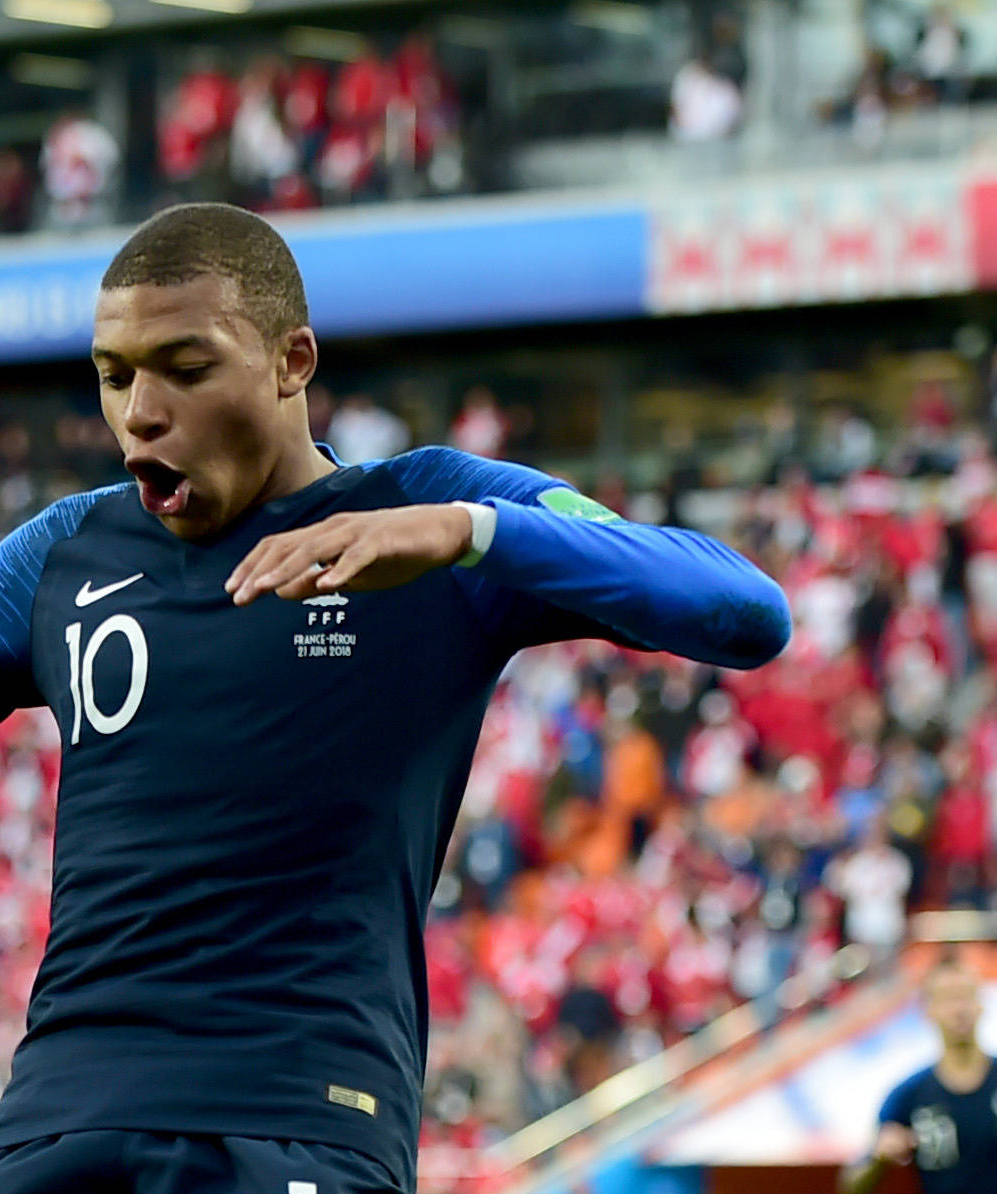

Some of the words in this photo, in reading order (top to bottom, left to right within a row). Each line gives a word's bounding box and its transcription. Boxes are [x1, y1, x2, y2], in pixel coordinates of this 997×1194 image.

[293, 632, 356, 645] FRANCE-PÉROU
[297, 646, 307, 657] 21
[309, 646, 327, 656] JUIN
[329, 646, 351, 656] 2018
[65, 614, 149, 745] 10
